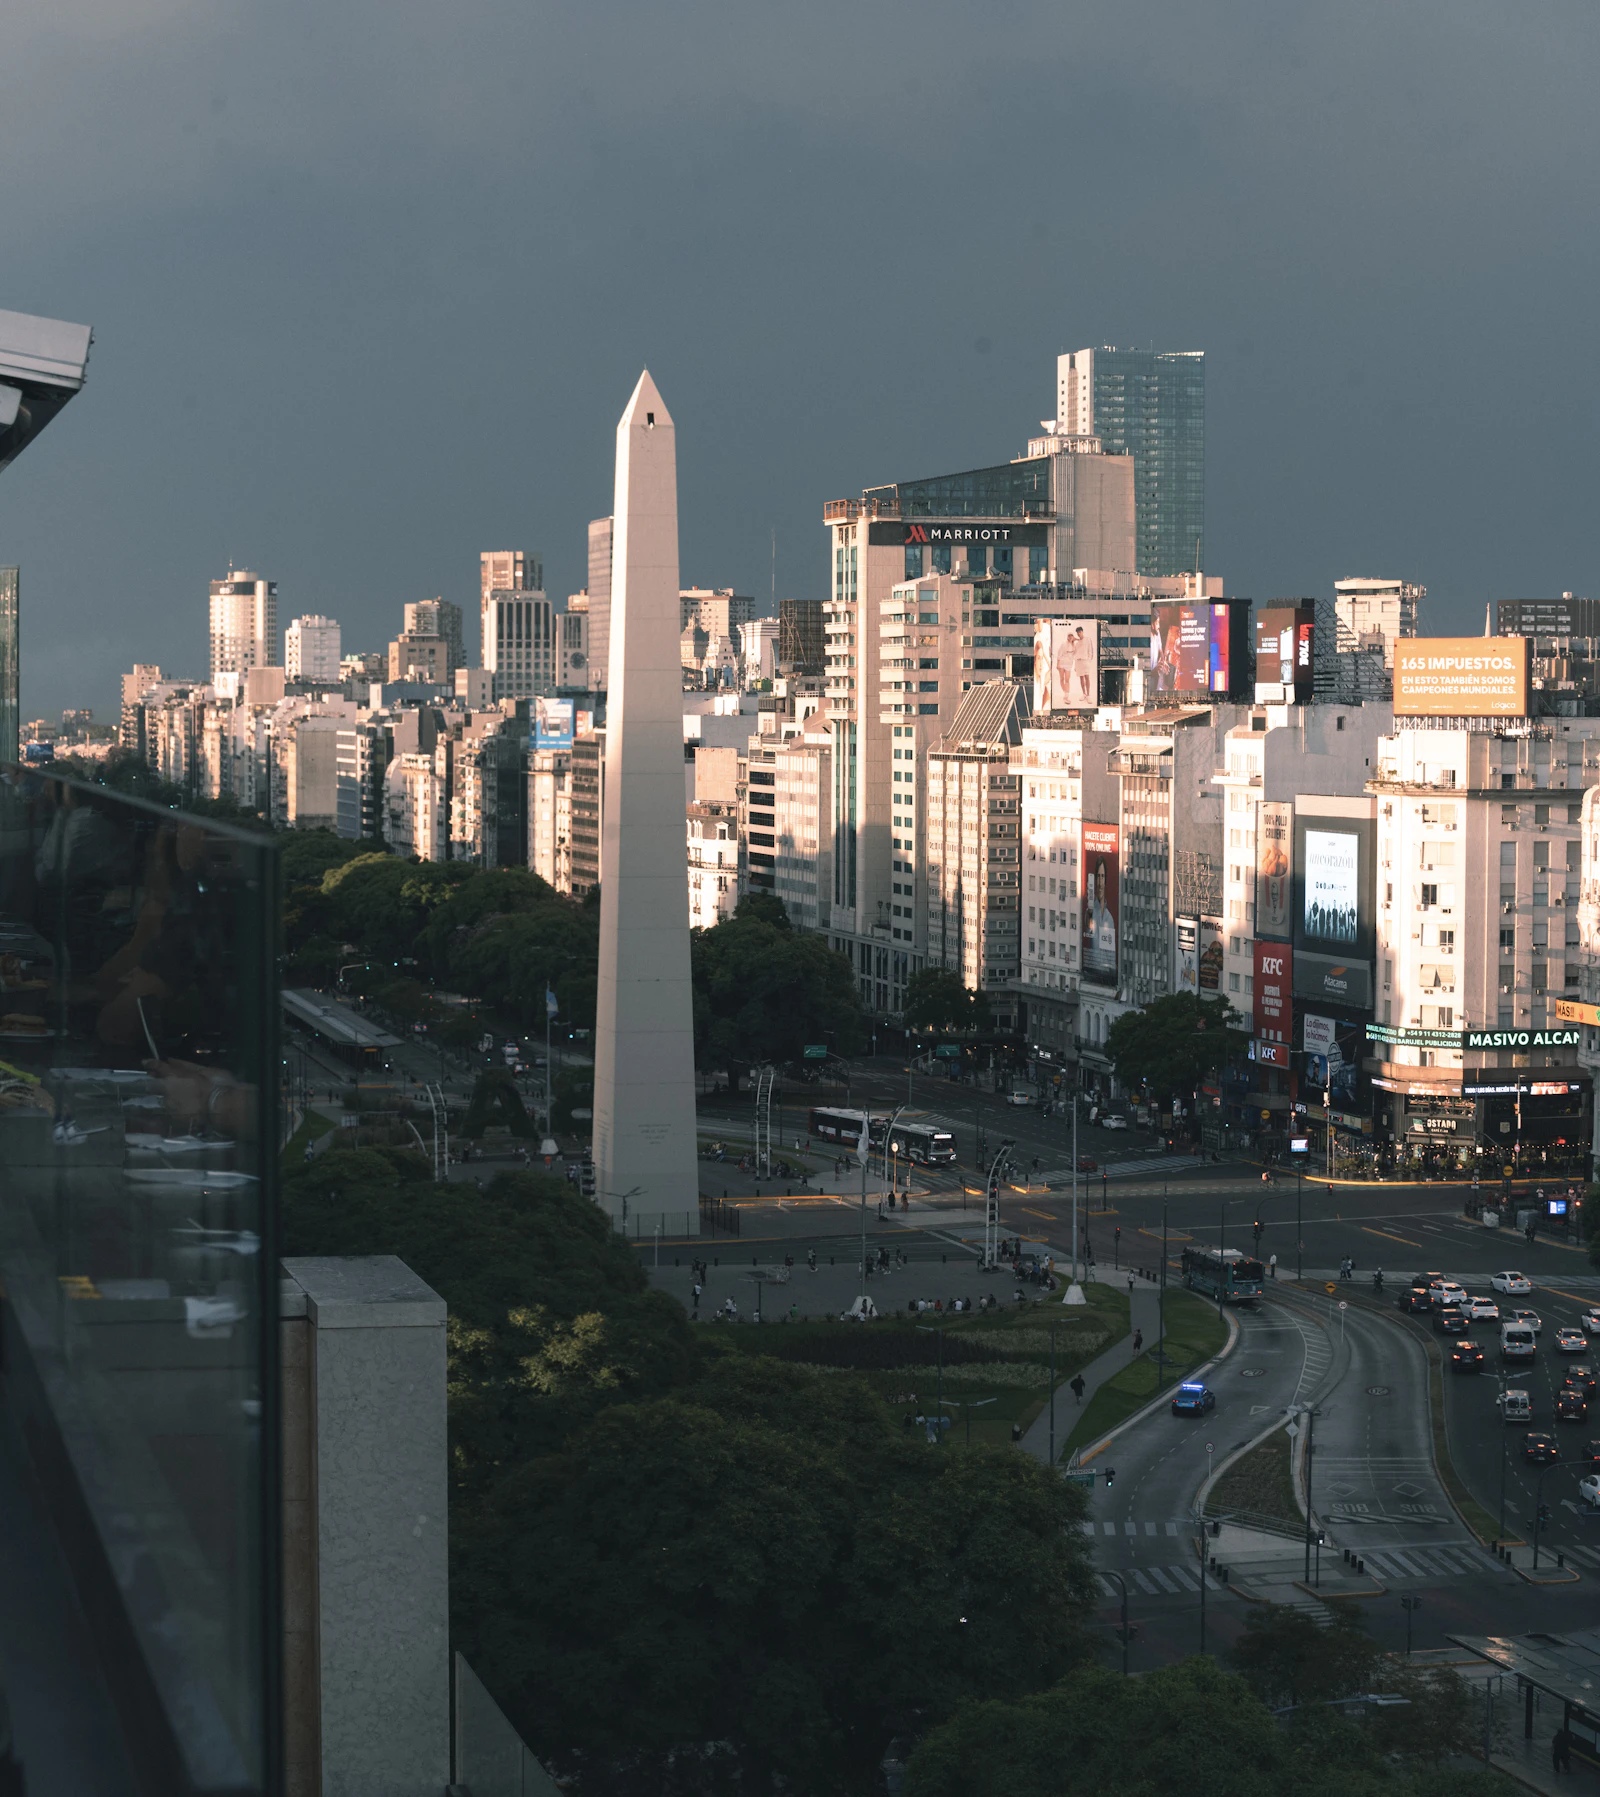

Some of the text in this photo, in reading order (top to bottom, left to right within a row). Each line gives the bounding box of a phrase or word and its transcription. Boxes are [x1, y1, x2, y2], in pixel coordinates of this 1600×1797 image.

[931, 529, 1010, 540] MARRIOTT
[1401, 656, 1516, 670] 165 IMPUESTOS.
[1401, 674, 1516, 685] EN ESTO TAMBIÉN SOMOS
[1402, 686, 1516, 694] CAMPEONES MUNDIALES.
[1275, 815, 1288, 827] POLLO
[1084, 830, 1116, 842] HACETE CLIENTE
[1261, 957, 1283, 976] KFC
[1324, 974, 1347, 989] Atacama
[1306, 1018, 1312, 1028] Lo
[1306, 1029, 1329, 1042] lo hicimos.
[1432, 1030, 1461, 1038] 4312-2828
[1397, 1038, 1424, 1046] BARUJEL
[1469, 1033, 1529, 1047] MASIVO
[1261, 1046, 1277, 1060] KFC
[1331, 1503, 1370, 1513] BUS
[1400, 1503, 1438, 1513] BUS
